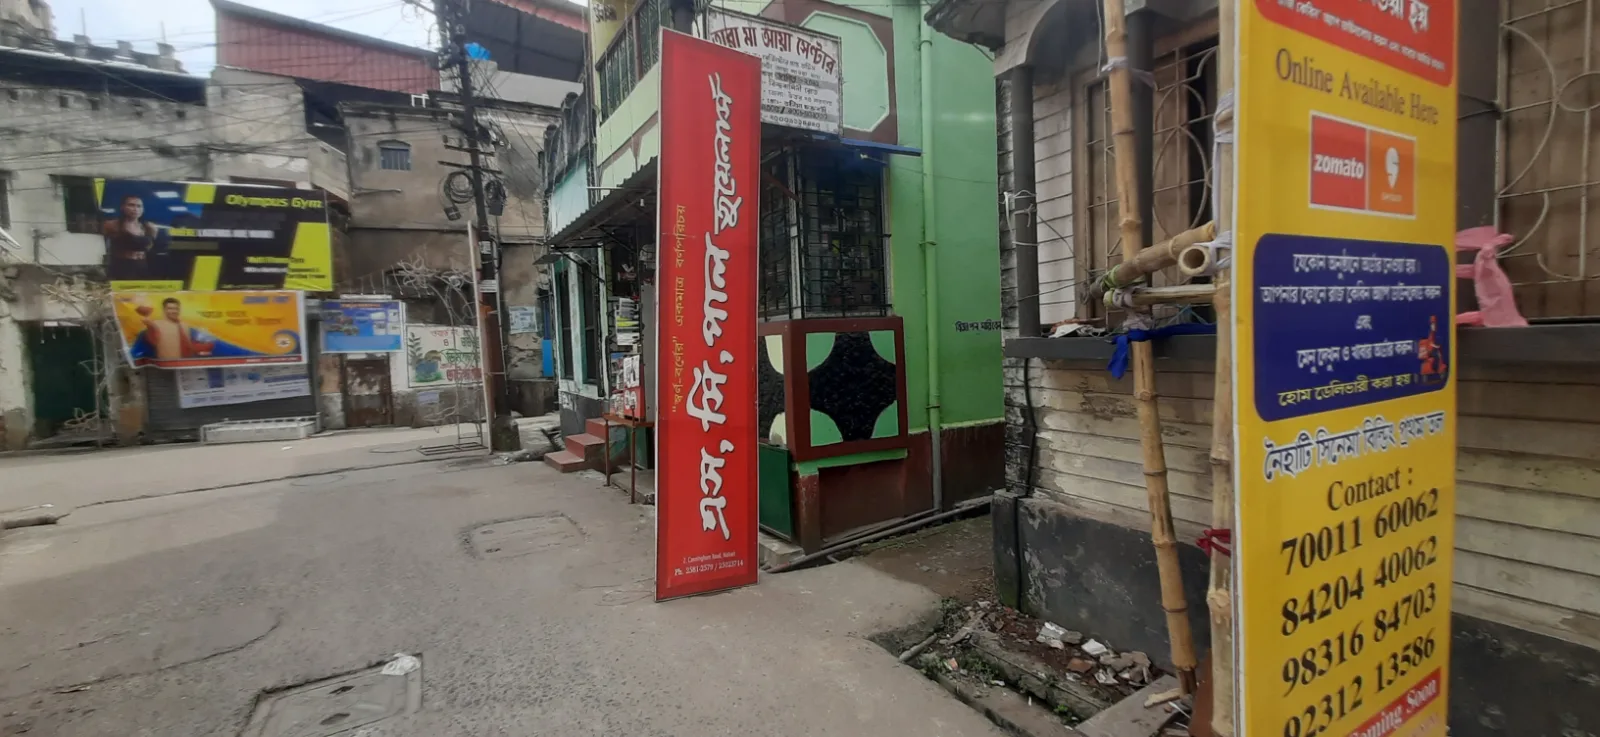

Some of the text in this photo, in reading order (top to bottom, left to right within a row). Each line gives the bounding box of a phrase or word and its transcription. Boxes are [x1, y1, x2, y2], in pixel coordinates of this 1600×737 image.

[742, 27, 758, 47] মা
[761, 27, 793, 52] আয়া
[1276, 48, 1438, 125] Online Available Here
[708, 72, 742, 235] জুয়েলার্স
[1314, 154, 1364, 179] zomato
[225, 194, 323, 210] Olympus Gym
[676, 277, 685, 326] একমাত্র
[703, 231, 731, 347] পাল
[1260, 285, 1298, 303] আপনার
[1277, 388, 1311, 406] হোম
[1315, 375, 1368, 400] ডেলিভারী
[1371, 376, 1393, 389] করা
[1395, 373, 1411, 387] হয়
[1263, 431, 1314, 481] নৈহাটি
[1316, 428, 1360, 466] সিনেমা
[1328, 468, 1400, 511] Contact
[1280, 488, 1438, 575] 70011 60062
[1281, 535, 1437, 636] 84204 40062
[1282, 582, 1436, 698] 98316 84703
[1374, 627, 1436, 693] 13586
[1406, 680, 1436, 713] Soon
